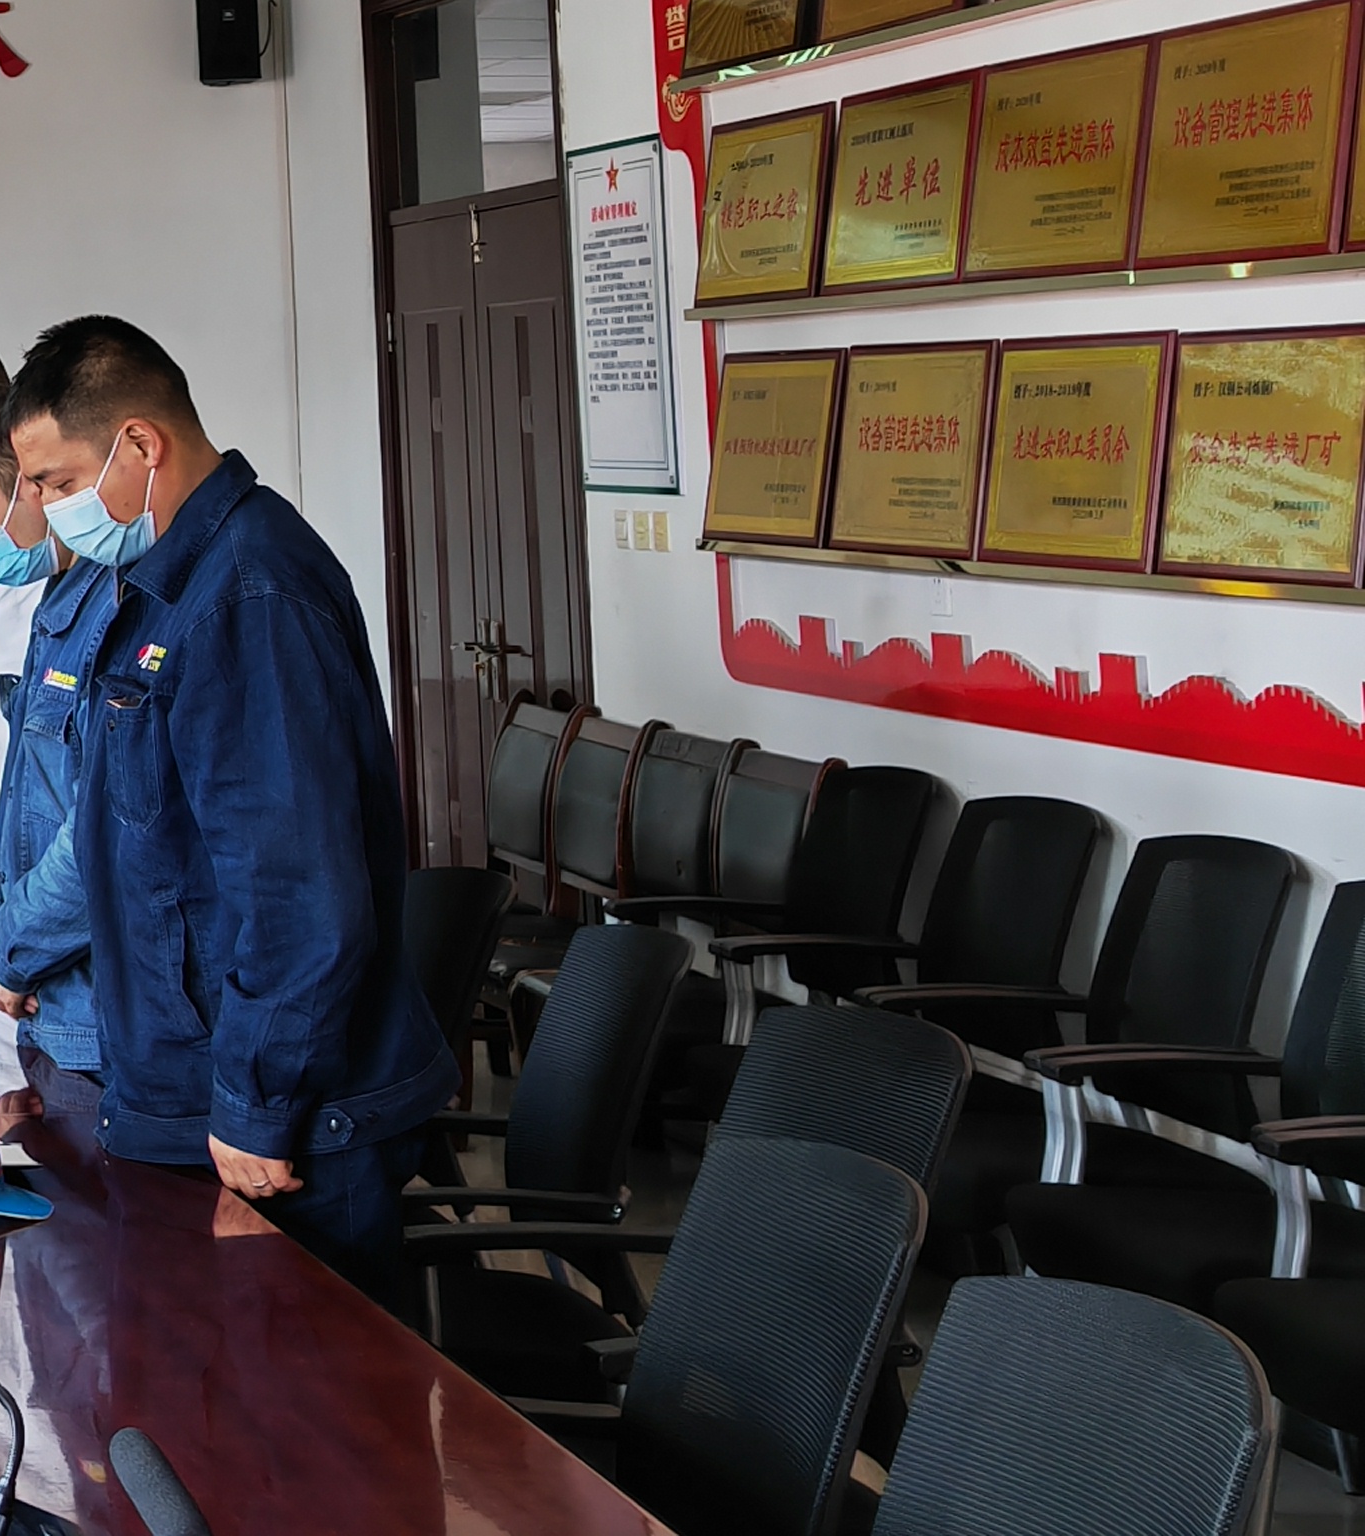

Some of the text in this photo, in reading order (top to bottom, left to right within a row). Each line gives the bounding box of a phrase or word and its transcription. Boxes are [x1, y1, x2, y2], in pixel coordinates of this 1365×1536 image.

[1173, 85, 1314, 148] 设备管理先进集体
[995, 117, 1115, 173] 成本效益先进集体
[854, 155, 941, 206] 先进单位
[720, 188, 799, 230] 模范职工之家
[858, 414, 961, 454] 设备管理先进集体
[1012, 423, 1130, 463] 先进女职工委员会
[1189, 430, 1342, 467] 安全生产先进厂矿
